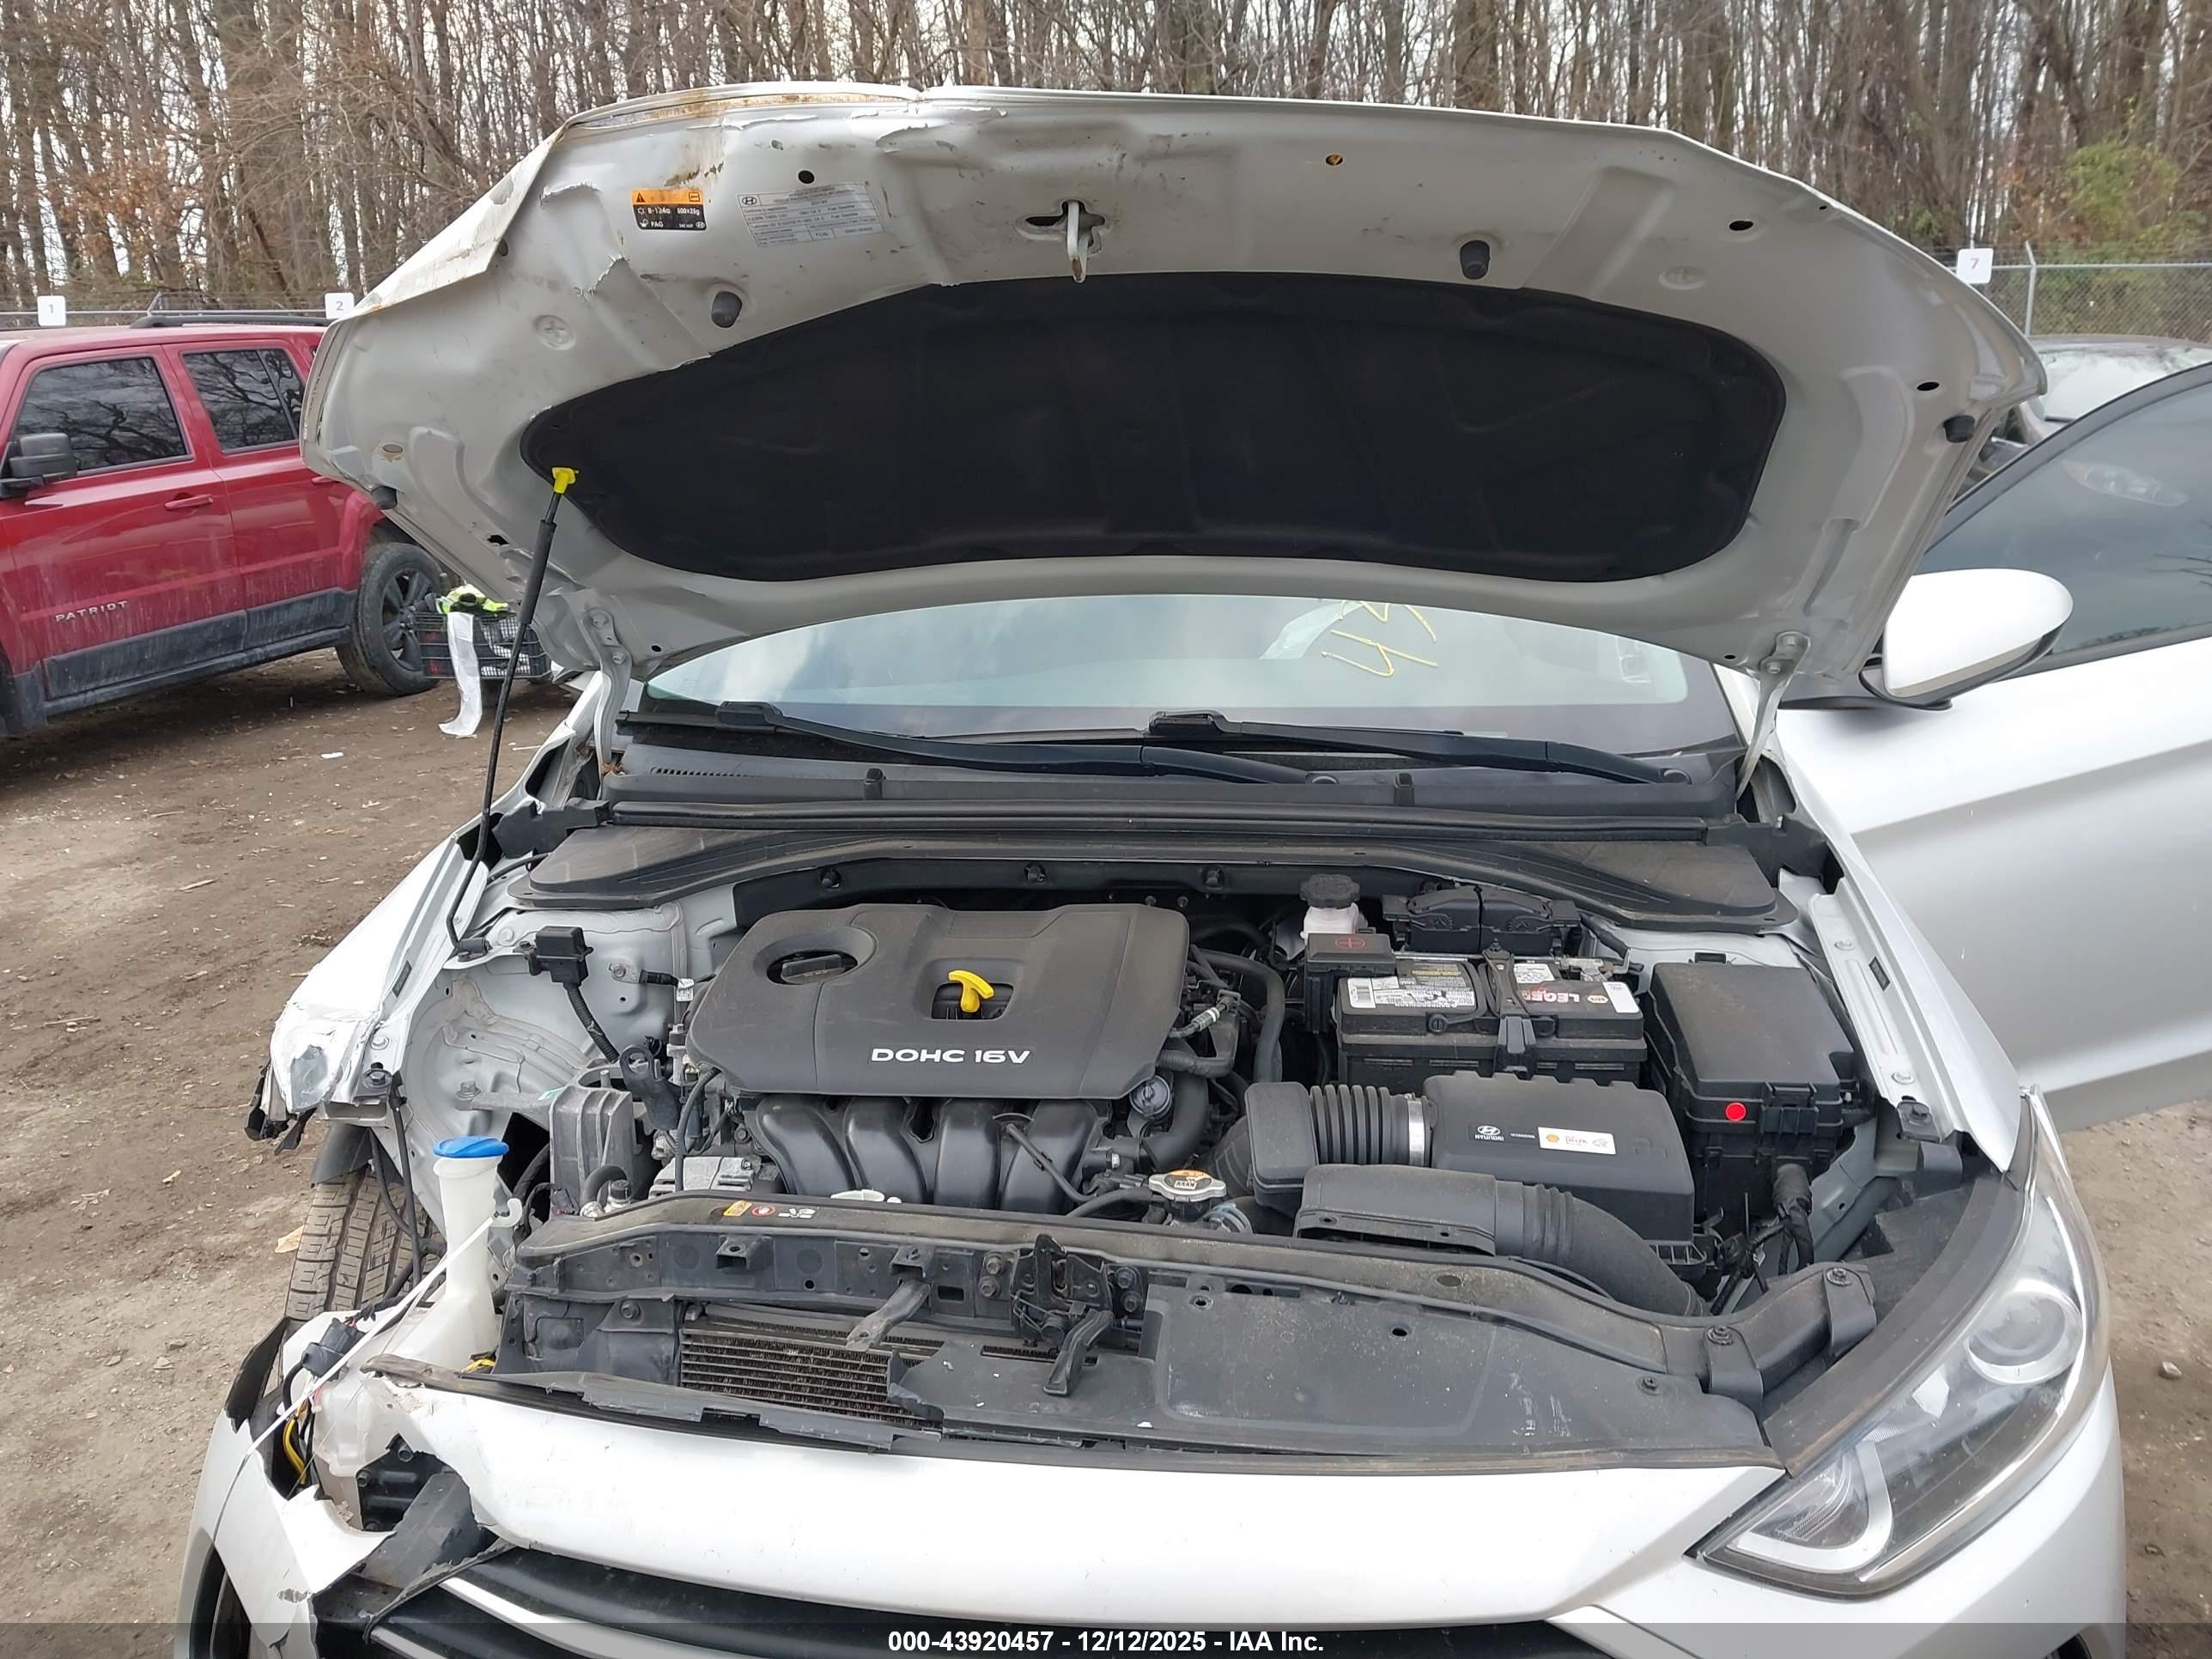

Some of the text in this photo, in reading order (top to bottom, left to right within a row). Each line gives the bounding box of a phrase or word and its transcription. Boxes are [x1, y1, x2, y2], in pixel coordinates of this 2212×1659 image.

[1971, 258, 1979, 269] 7
[336, 301, 343, 310] 2
[55, 600, 127, 622] PATRIOT
[872, 1048, 1030, 1064] DOHC 16V
